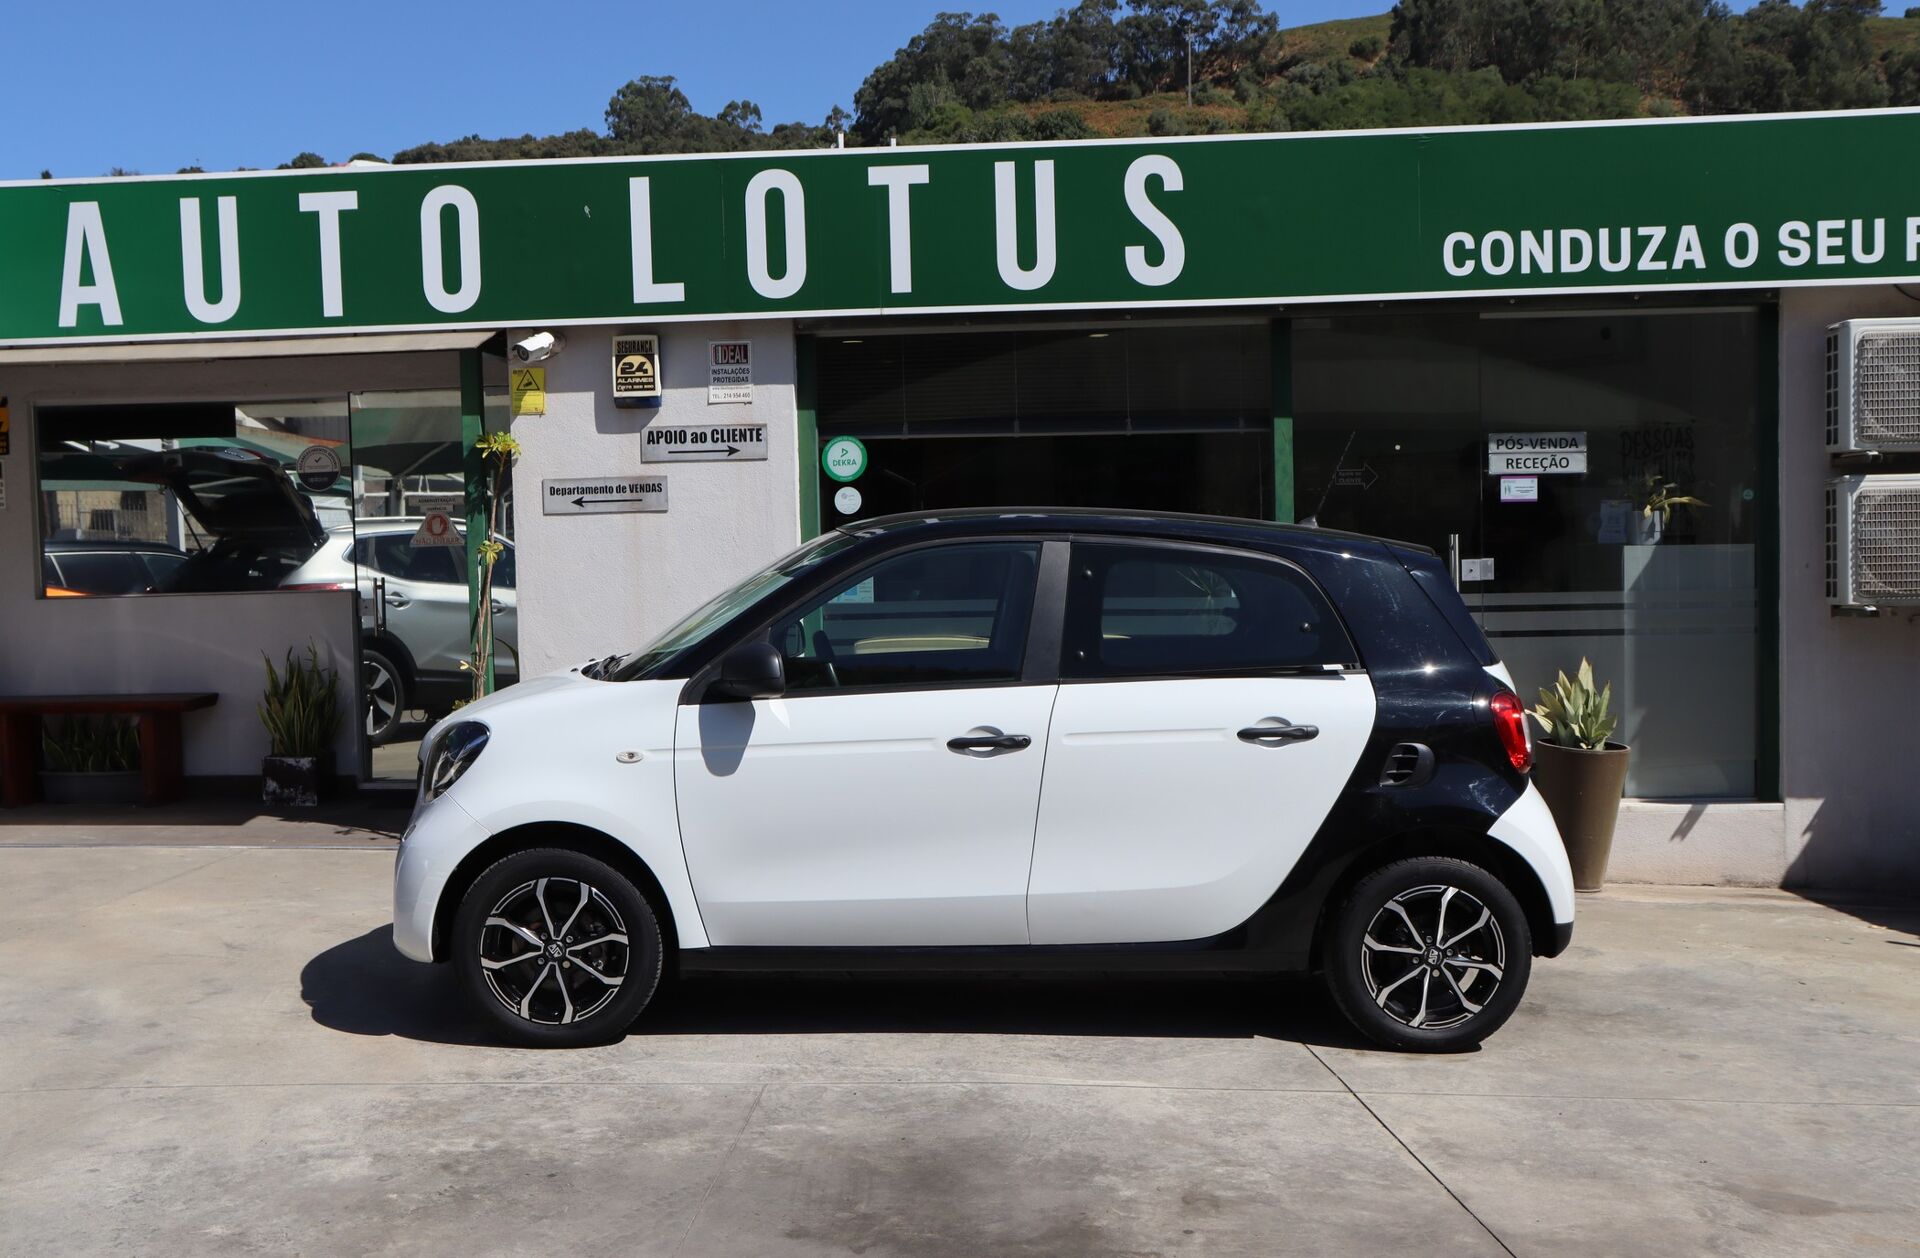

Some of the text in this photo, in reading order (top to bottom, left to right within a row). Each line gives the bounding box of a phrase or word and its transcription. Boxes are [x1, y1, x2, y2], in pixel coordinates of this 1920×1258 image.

[58, 154, 1186, 328] AUTO LOTUS
[1443, 224, 1707, 277] CONDUZA
[1724, 222, 1759, 269] O
[1777, 217, 1886, 267] SEU
[719, 345, 748, 364] IDEAL
[620, 361, 649, 376] 24
[711, 367, 750, 376] INSTALAÇÕES
[646, 428, 763, 445] APOIO ao CLIENTE
[1496, 436, 1579, 450] PÓS-VENDA
[832, 458, 857, 467] DEKRA
[1505, 454, 1570, 471] RECEÇÃO
[549, 482, 663, 496] Departamento de VENDAS
